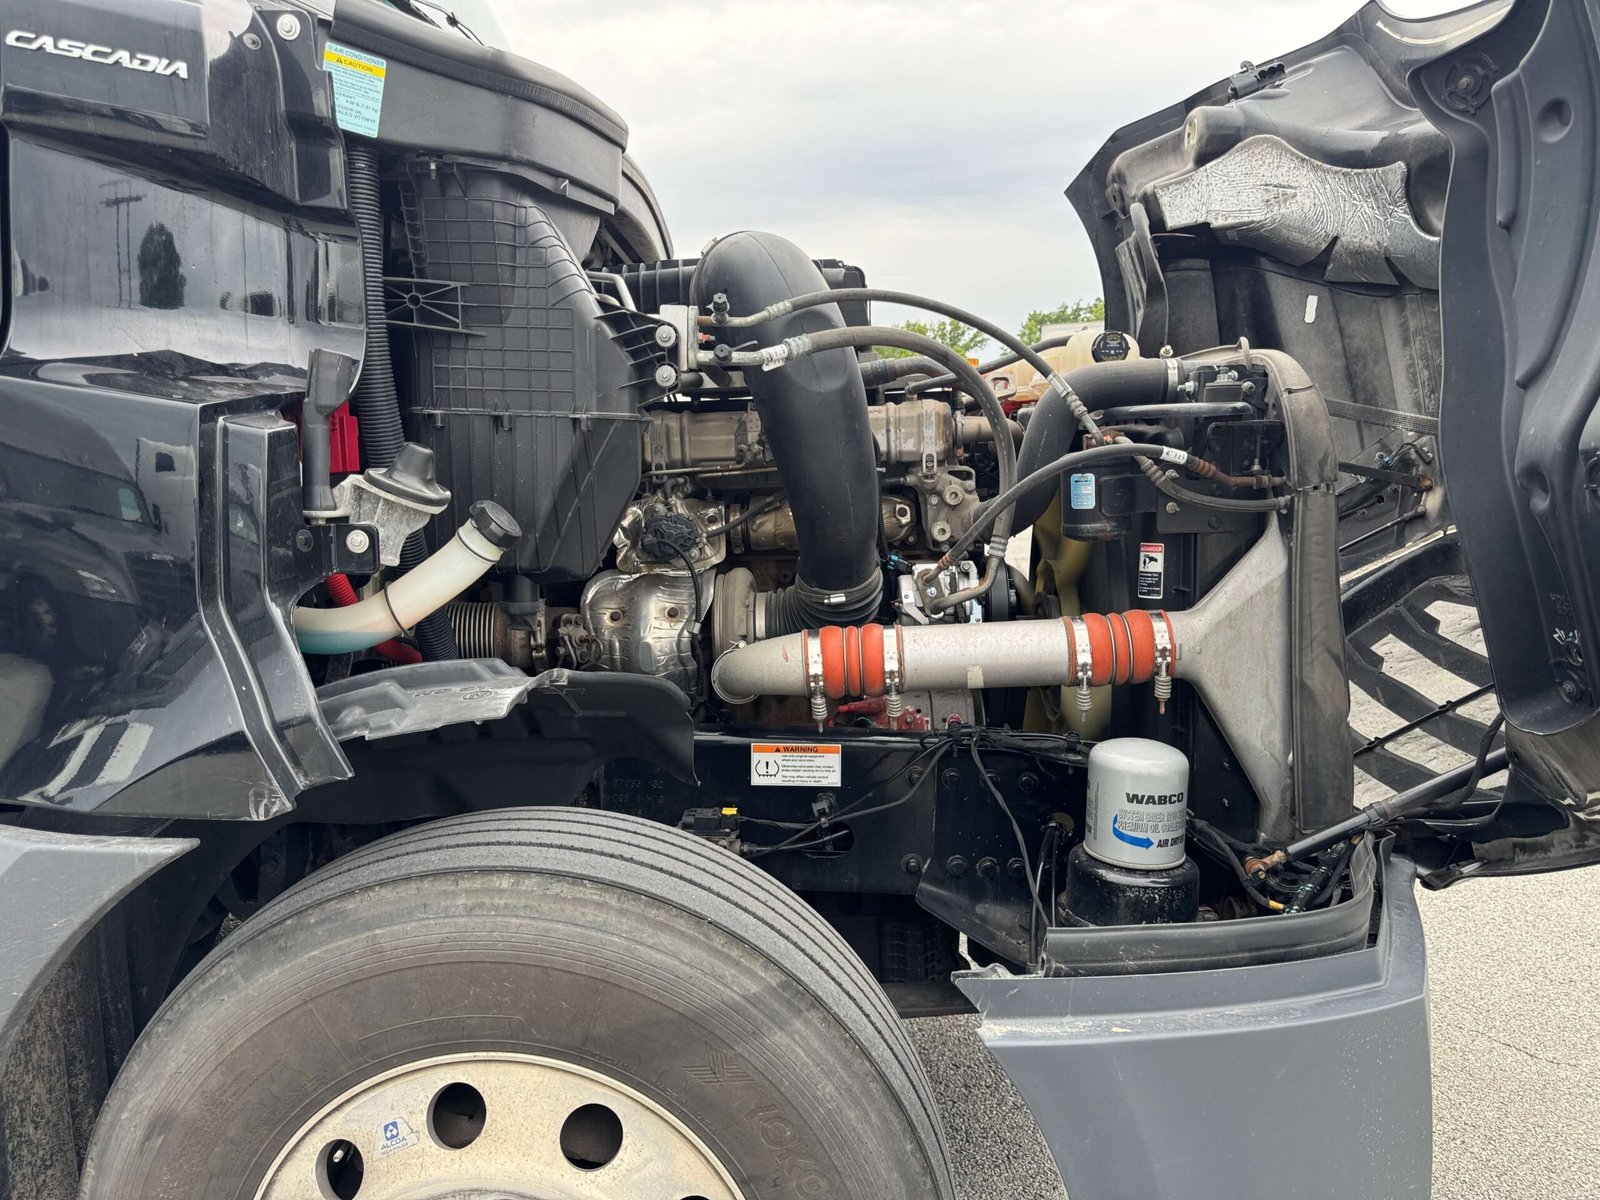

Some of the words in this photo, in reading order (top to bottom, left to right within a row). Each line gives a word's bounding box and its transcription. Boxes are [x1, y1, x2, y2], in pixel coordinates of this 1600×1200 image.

[5, 28, 189, 80] CASCADIA
[345, 50, 385, 67] CONDITIONER
[343, 59, 373, 73] CAUTION
[1125, 792, 1184, 805] WABCO
[1118, 810, 1145, 822] SYSTEM
[1117, 820, 1149, 833] PREMIUM
[1156, 838, 1170, 848] AIR
[381, 1136, 407, 1151] ALCOA
